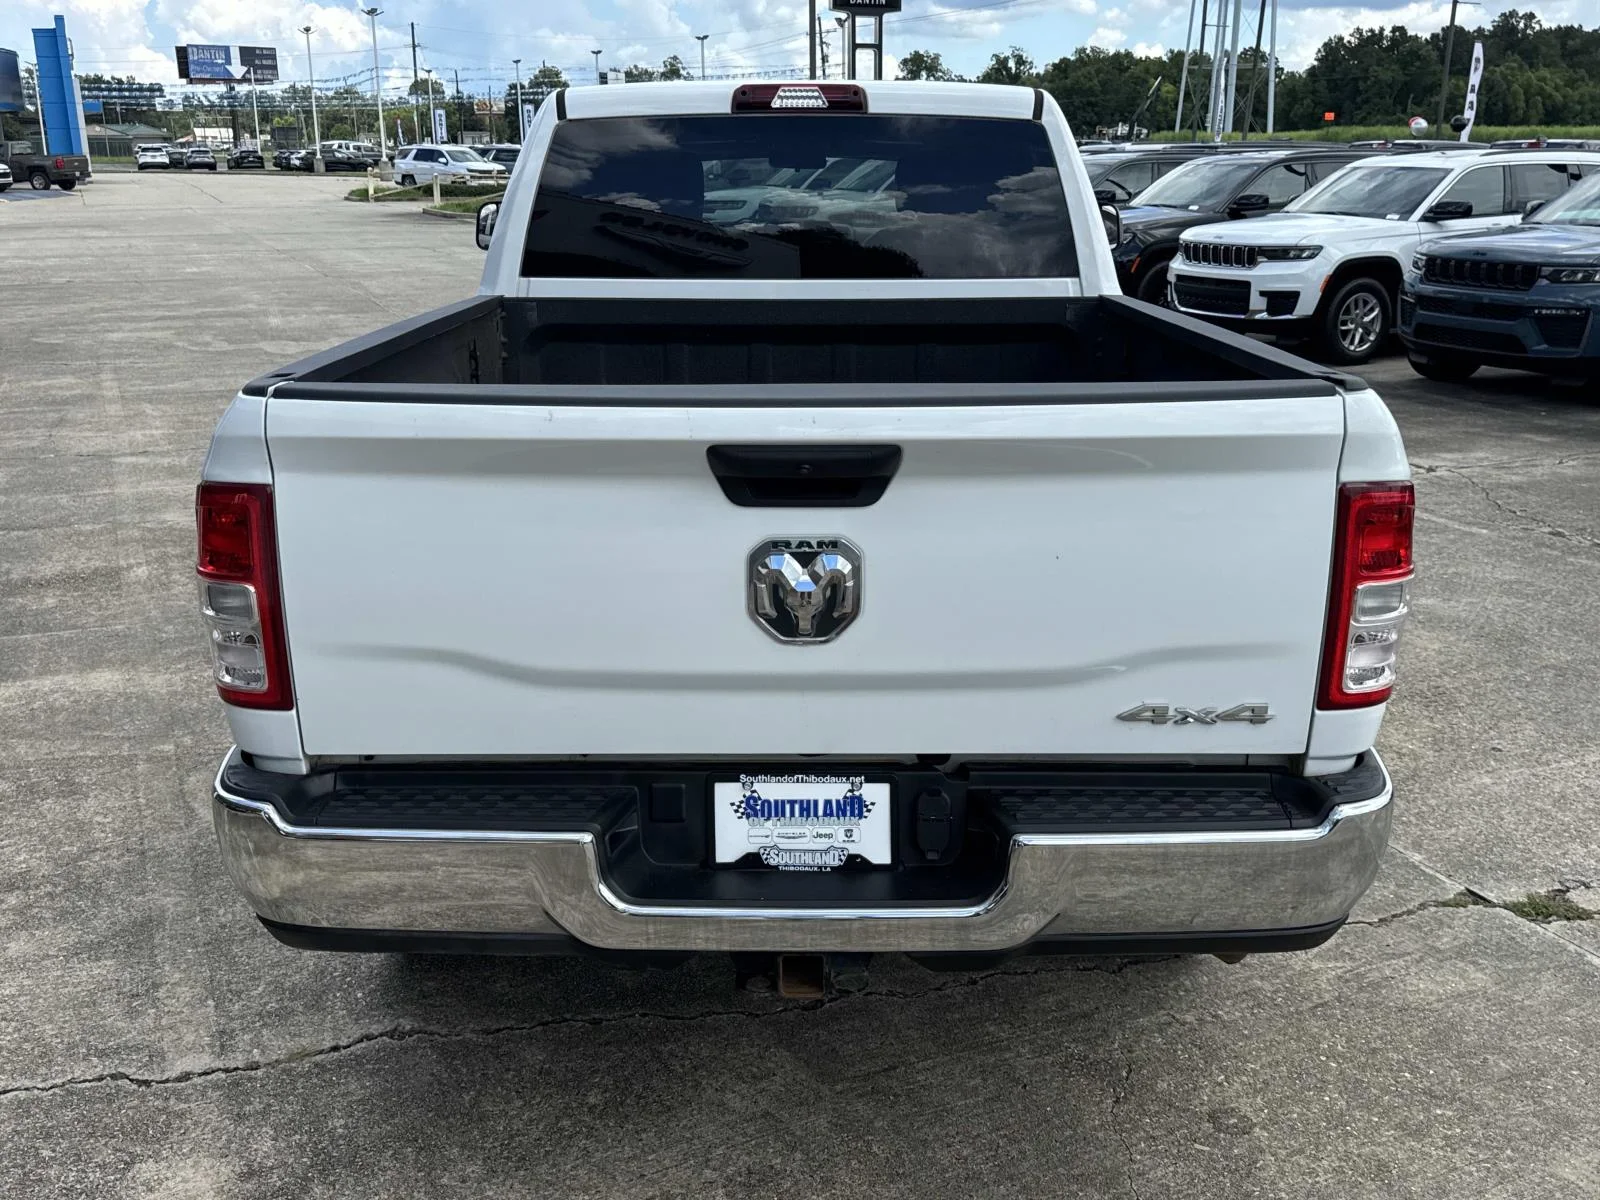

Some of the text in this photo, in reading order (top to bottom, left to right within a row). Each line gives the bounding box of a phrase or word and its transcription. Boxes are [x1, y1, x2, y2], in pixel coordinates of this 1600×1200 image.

[188, 48, 225, 60] DANTIN
[771, 539, 839, 550] RAM
[1115, 702, 1277, 725] 4x4
[740, 775, 865, 783] SouthlandofThibodaux.net
[744, 795, 865, 820] SOUTHLAND
[772, 817, 861, 827] THIBODAUX
[812, 831, 834, 840] Jeep
[769, 849, 839, 866] SOUTHLAND
